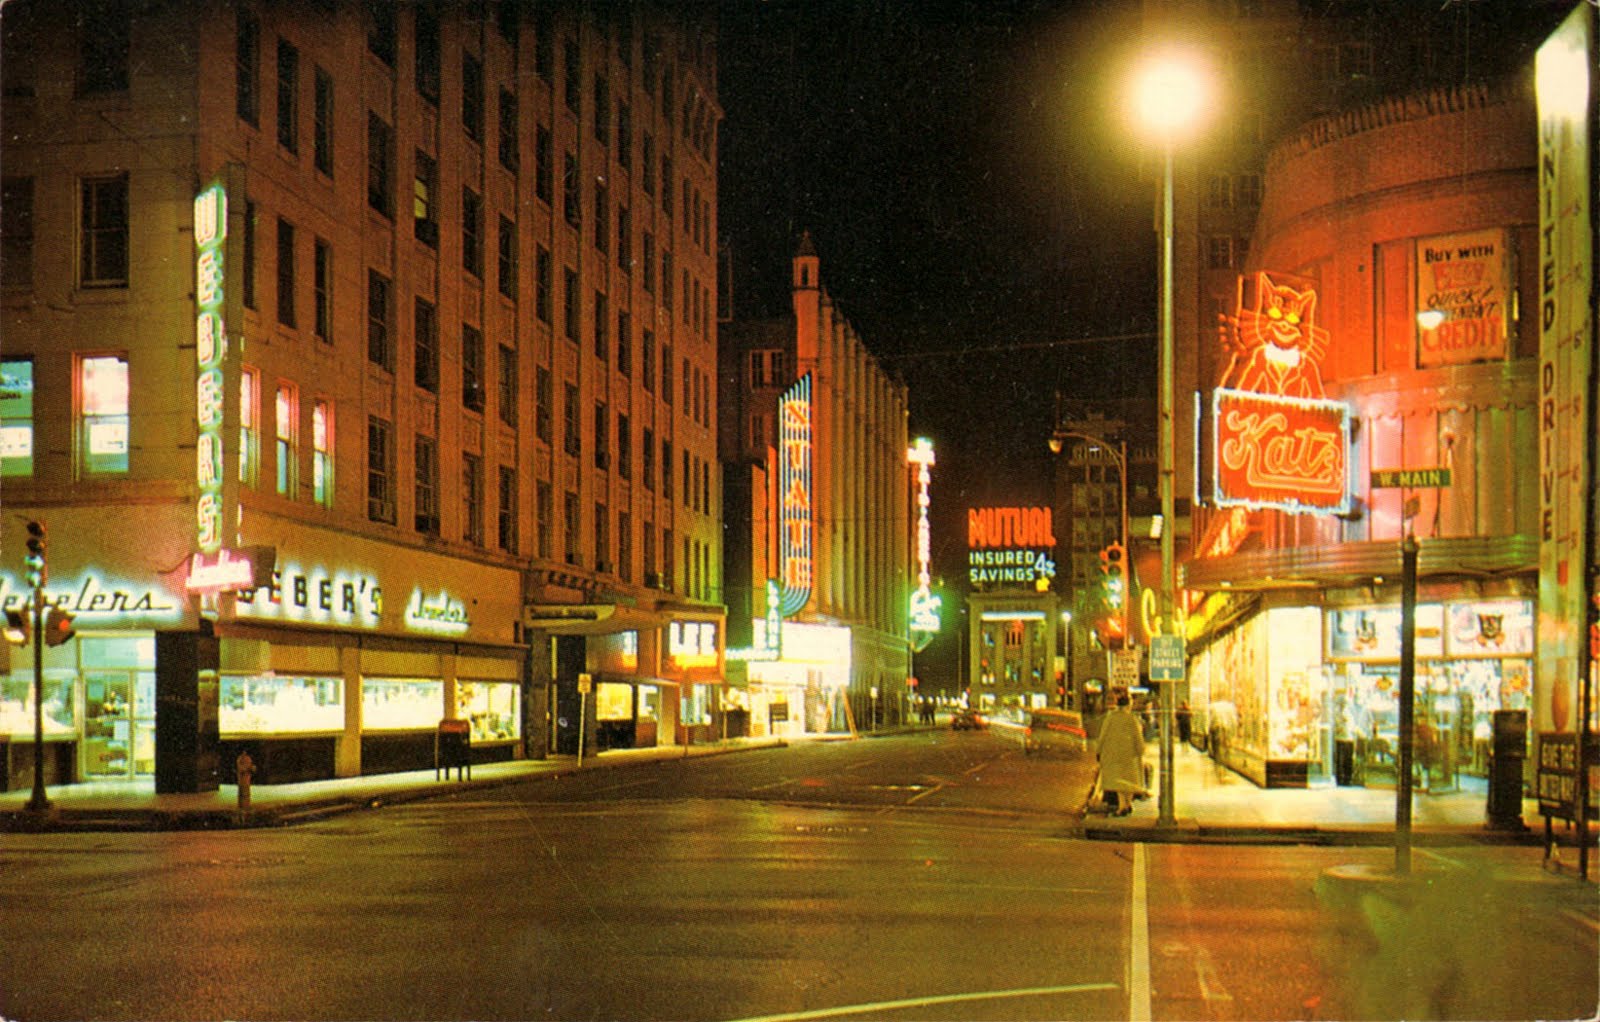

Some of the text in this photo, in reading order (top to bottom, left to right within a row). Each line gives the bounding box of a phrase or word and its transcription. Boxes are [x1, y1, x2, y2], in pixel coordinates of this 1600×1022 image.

[1422, 317, 1500, 352] CREDIT
[1222, 410, 1343, 493] Katz
[1542, 361, 1555, 542] DRIVE
[783, 399, 811, 588] STATE
[1399, 469, 1440, 487] MAIN
[968, 506, 1057, 548] MUTUAL
[969, 550, 1035, 566] INSURED
[969, 566, 1035, 582] SAVINGS
[0, 575, 173, 611] ewelers
